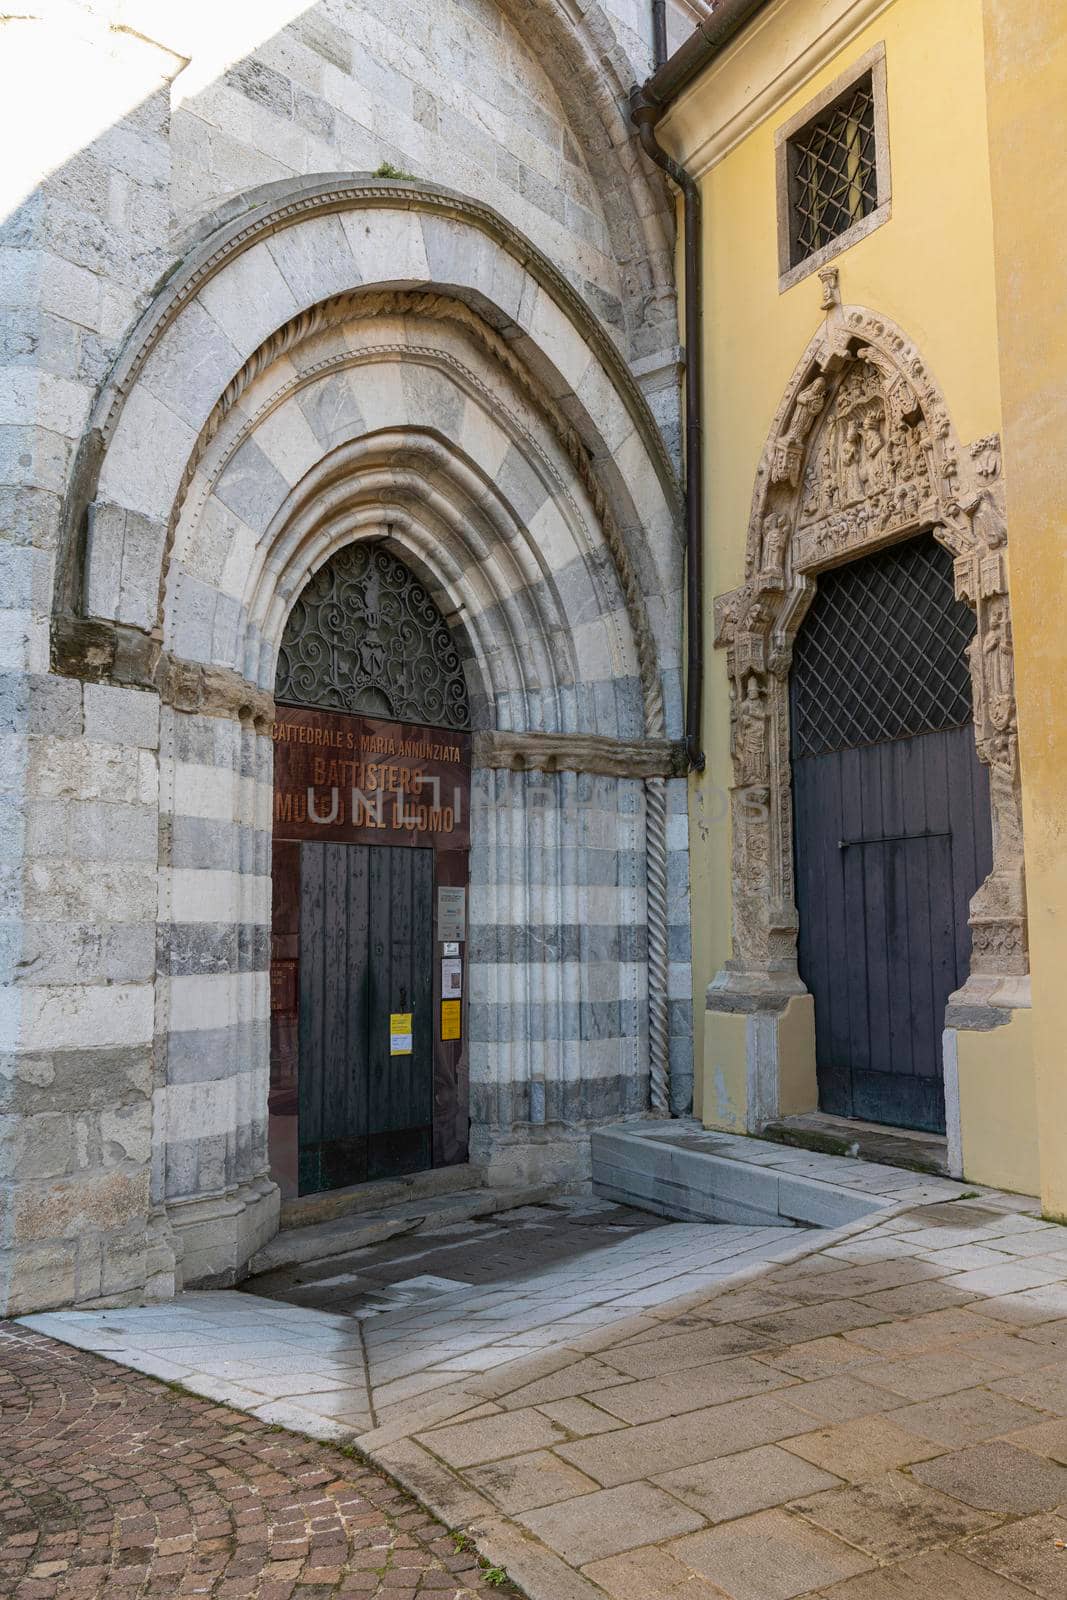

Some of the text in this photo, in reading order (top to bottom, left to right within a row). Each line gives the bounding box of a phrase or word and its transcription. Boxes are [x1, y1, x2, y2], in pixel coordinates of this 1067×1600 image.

[272, 722, 461, 763] CATTEDRALE S. MARIA ANNUNZIATA
[313, 757, 424, 795] BATTISTERO
[353, 799, 386, 829] DEL
[392, 801, 454, 833] DUOMO
